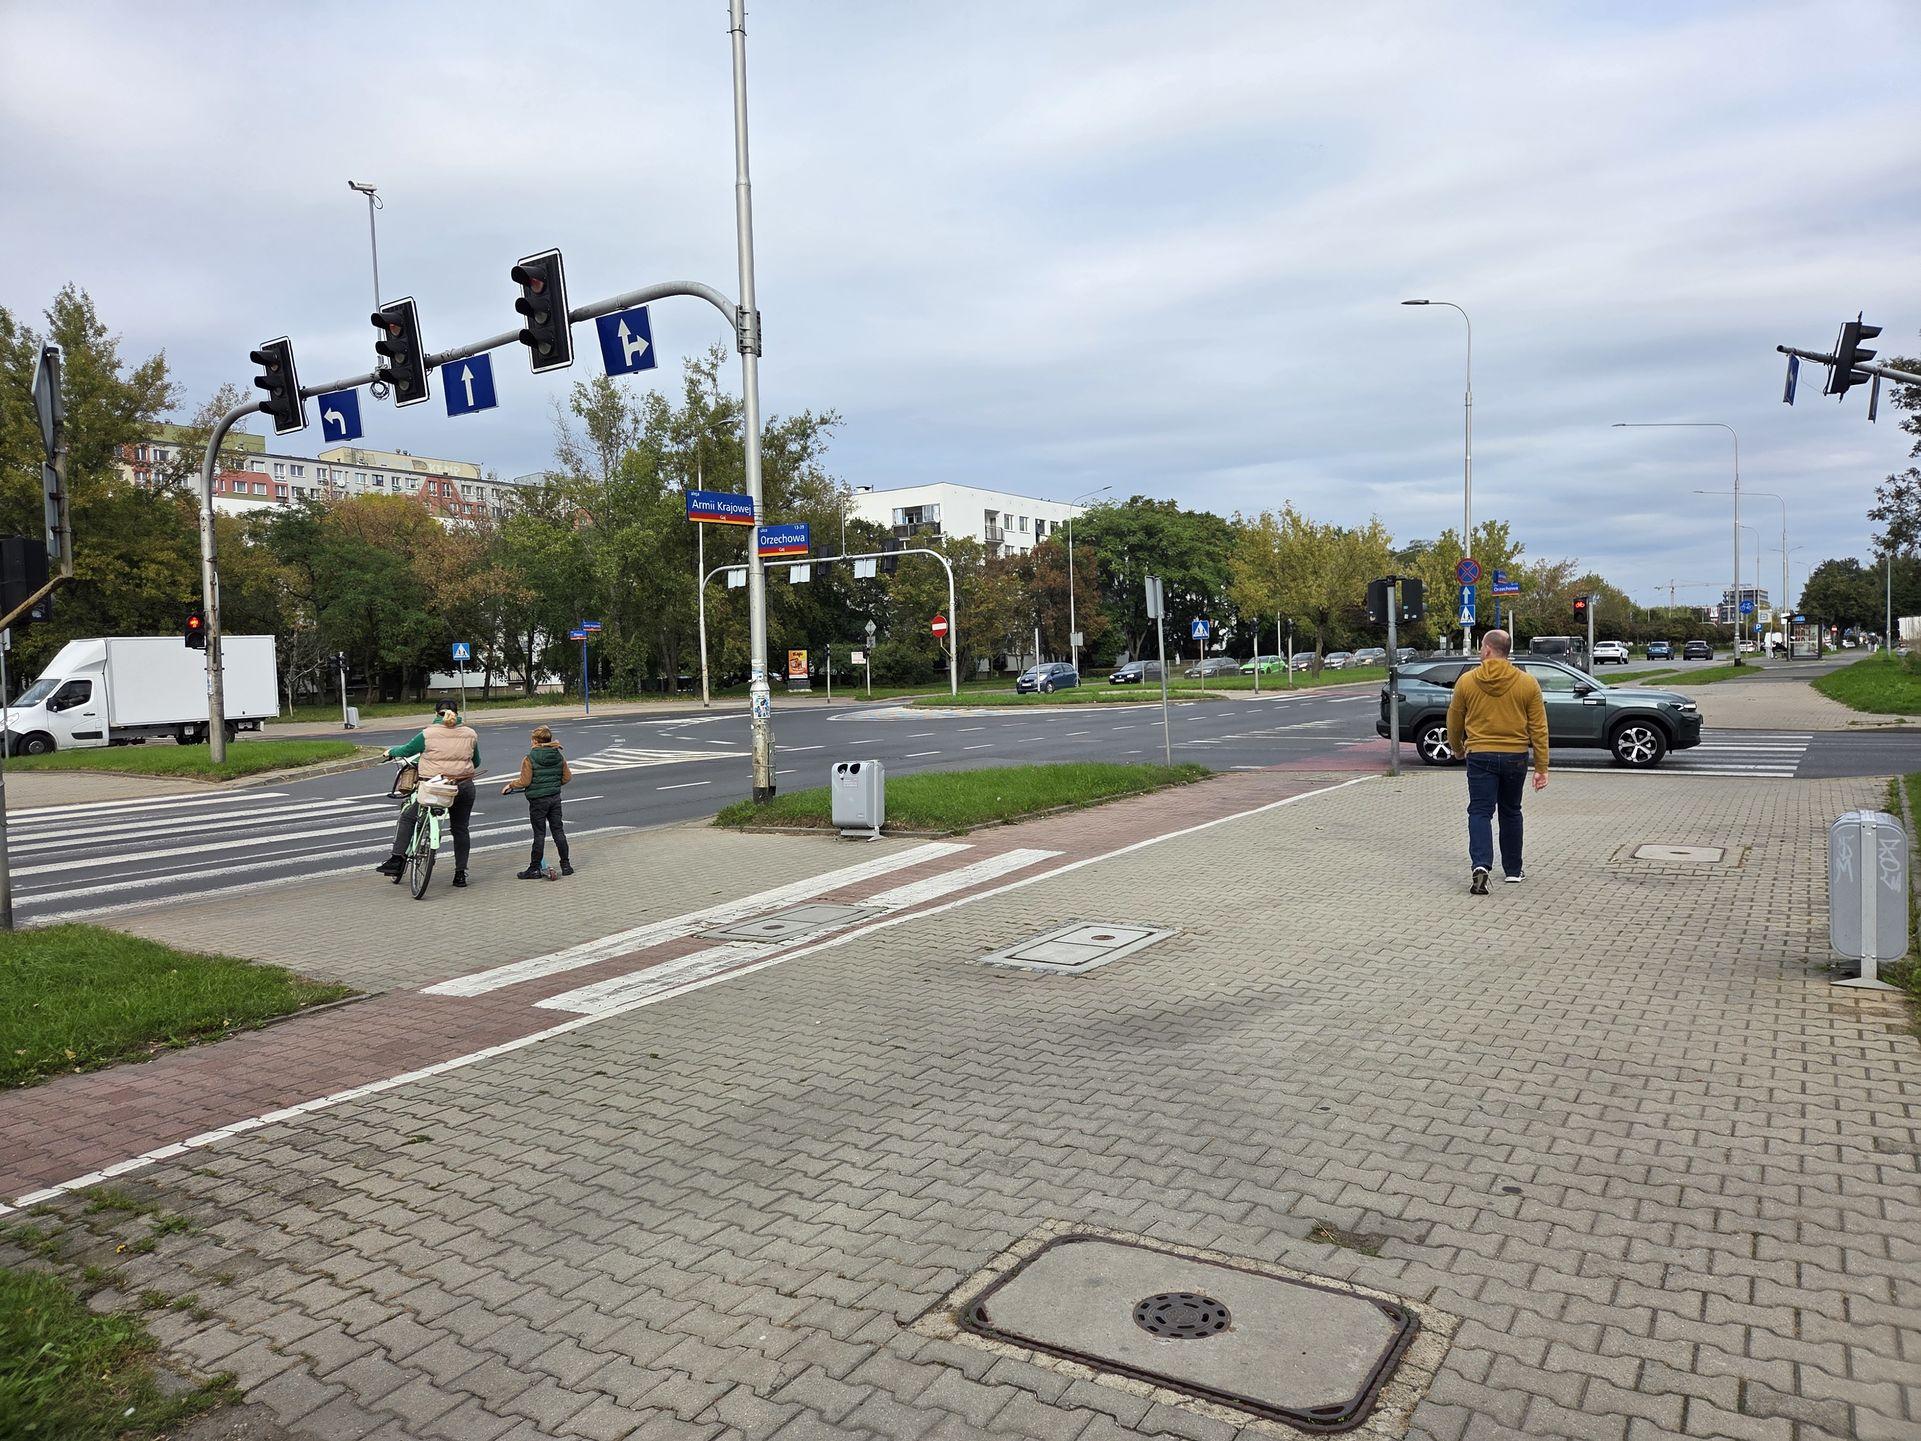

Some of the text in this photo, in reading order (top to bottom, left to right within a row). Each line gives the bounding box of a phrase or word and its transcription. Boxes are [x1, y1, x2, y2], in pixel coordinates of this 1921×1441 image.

[692, 499, 752, 516] Armii Krajowej
[760, 534, 805, 545] Orzechowa
